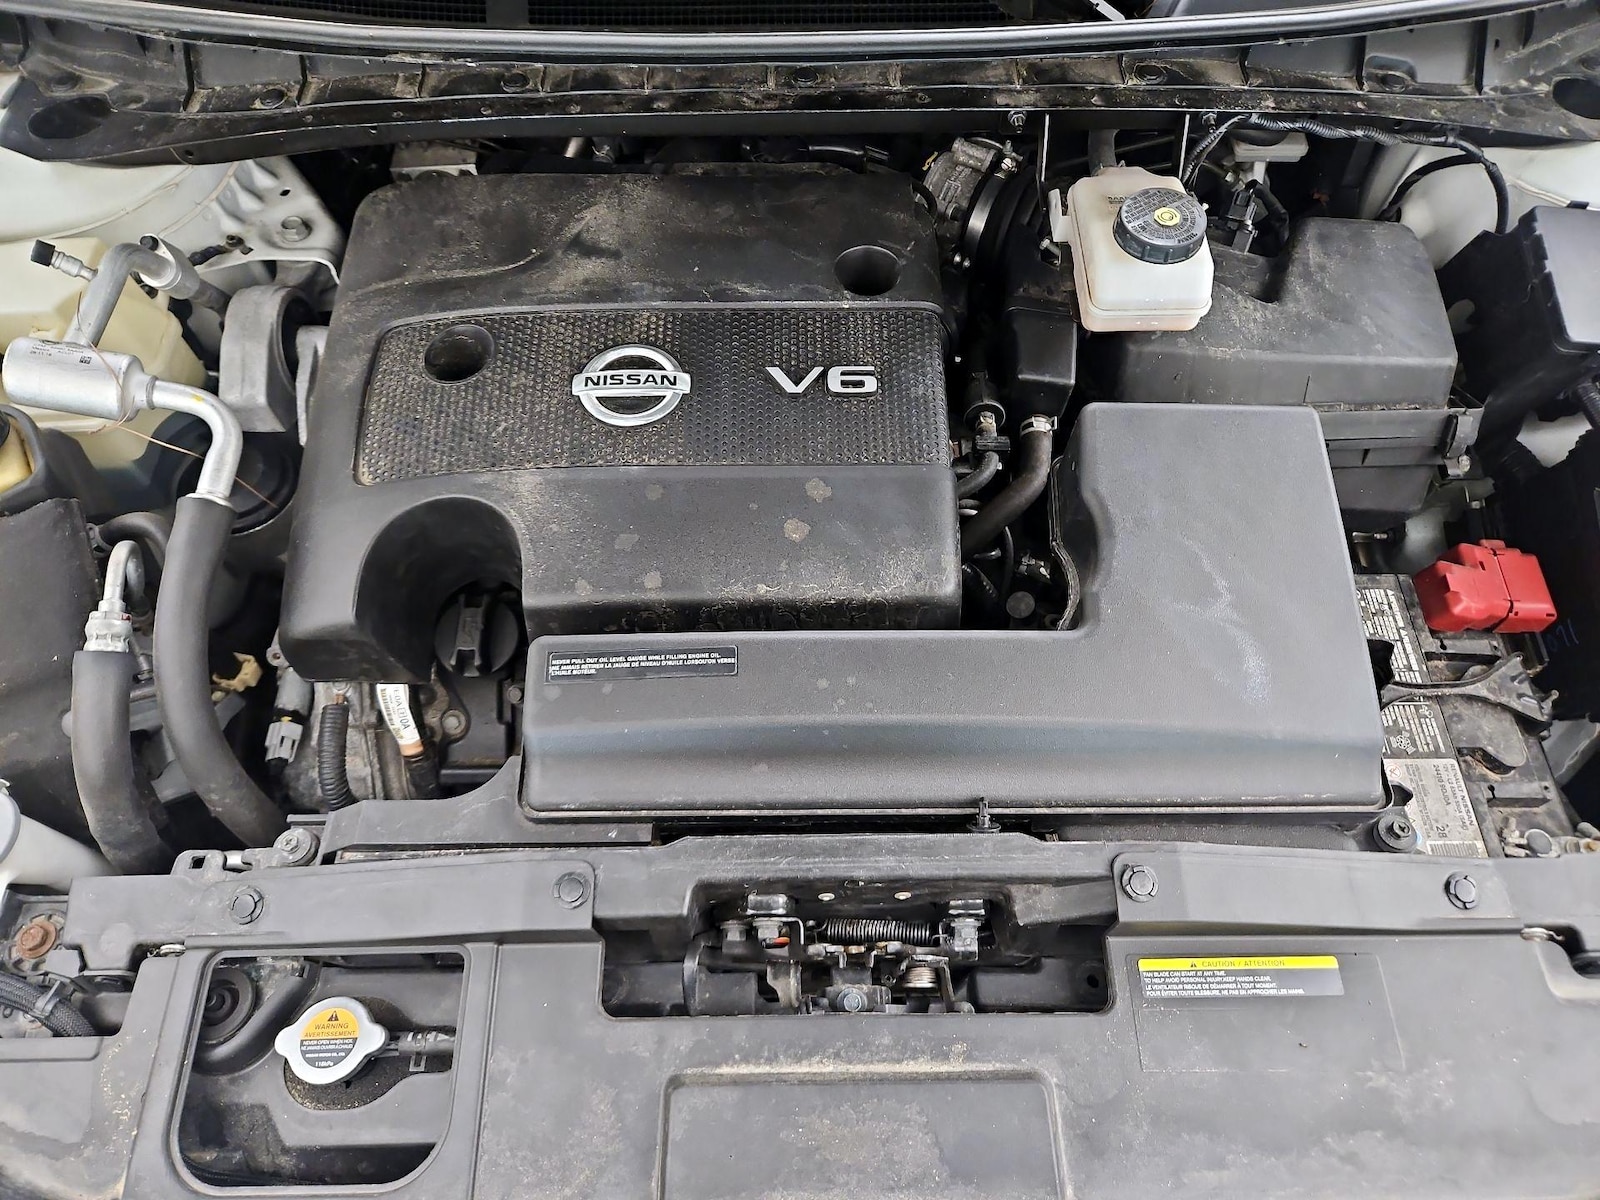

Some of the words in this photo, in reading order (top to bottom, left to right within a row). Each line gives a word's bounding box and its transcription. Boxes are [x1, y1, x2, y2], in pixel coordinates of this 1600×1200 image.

[584, 374, 678, 388] NISSAN
[765, 366, 878, 393] V6
[1450, 764, 1464, 792] RENAULT
[1460, 794, 1474, 826] NISSAN
[1436, 825, 1448, 838] 28
